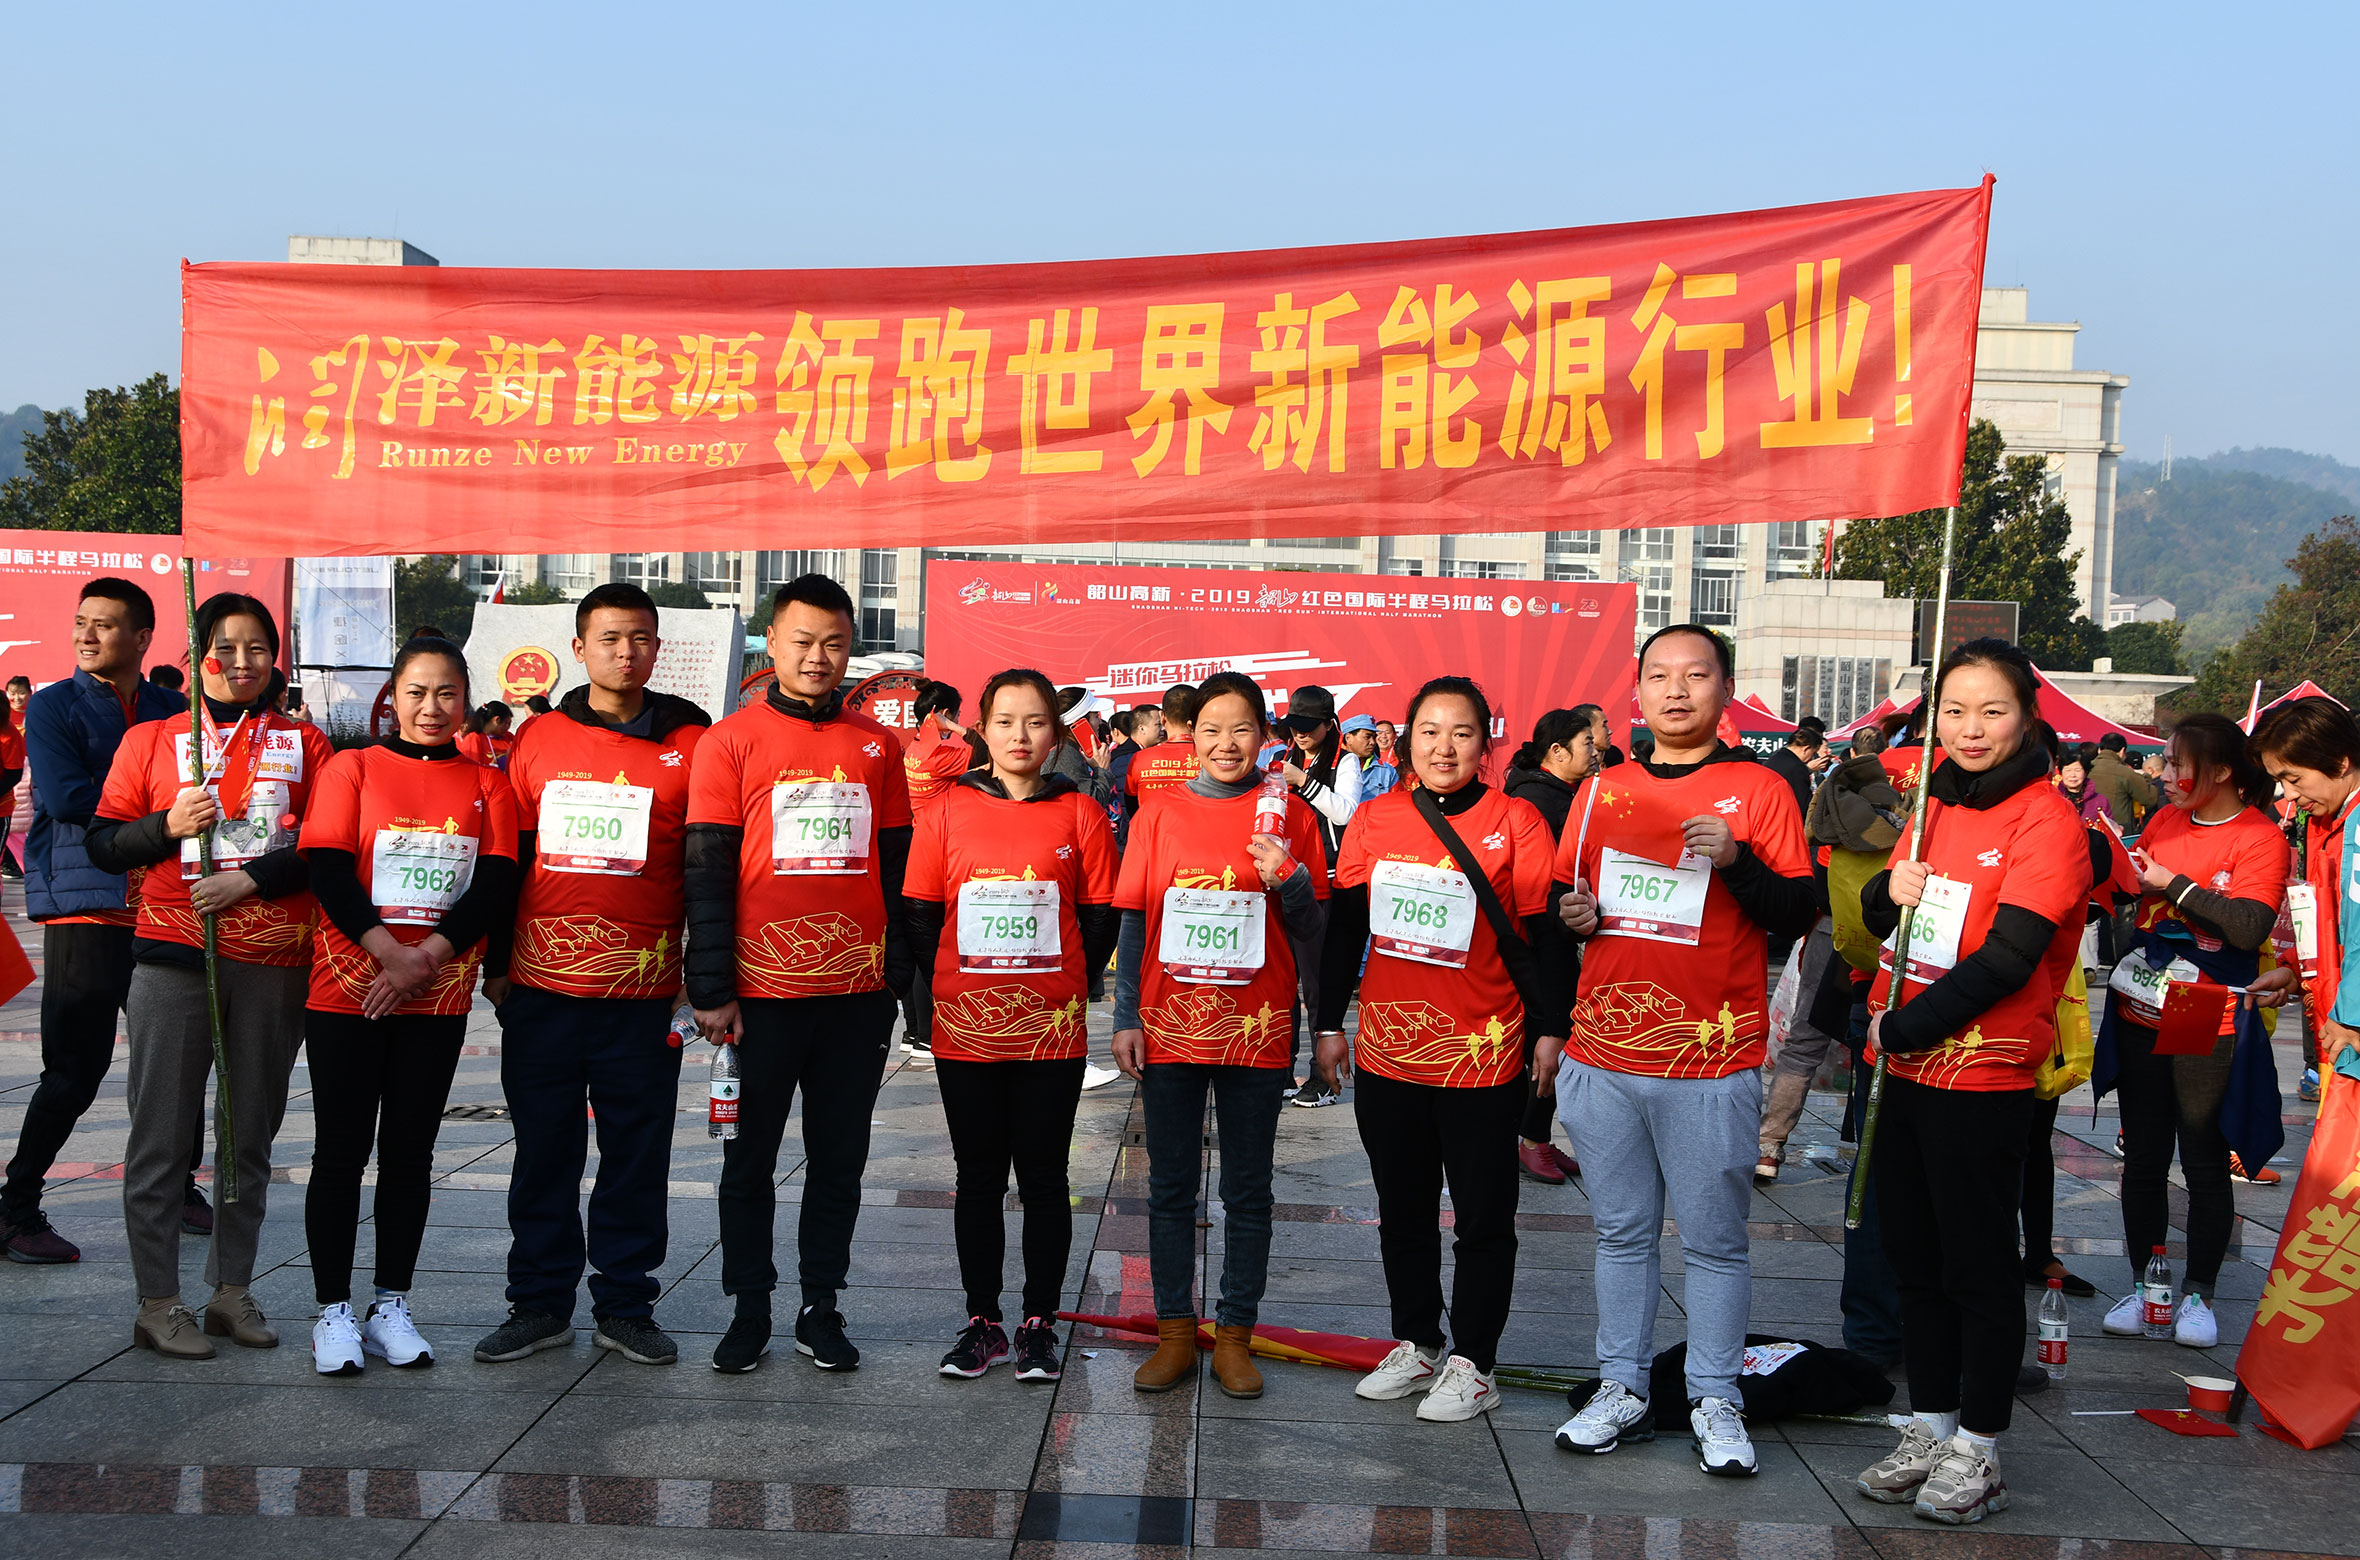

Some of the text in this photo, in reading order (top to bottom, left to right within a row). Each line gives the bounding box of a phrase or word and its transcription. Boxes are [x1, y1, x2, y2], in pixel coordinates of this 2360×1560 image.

[773, 257, 1914, 493] 领跑世界新能源行业!
[378, 436, 749, 469] Runze New Energy
[1109, 660, 1232, 688] 迷你马拉松
[1839, 661, 1852, 727] 韶山市人民
[557, 771, 593, 779] 1949-2019
[779, 769, 814, 777] 1949-2019
[394, 816, 426, 825] 1949-2019
[563, 815, 622, 840] 7960
[797, 817, 852, 840] 7964
[1385, 852, 1419, 862] 1949-2019
[399, 866, 456, 893] 7962
[1176, 867, 1205, 876] 1949-2019
[1618, 874, 1679, 903] 7967
[1391, 896, 1449, 929] 7968
[981, 915, 1038, 939] 7959
[1184, 924, 1239, 950] 7961
